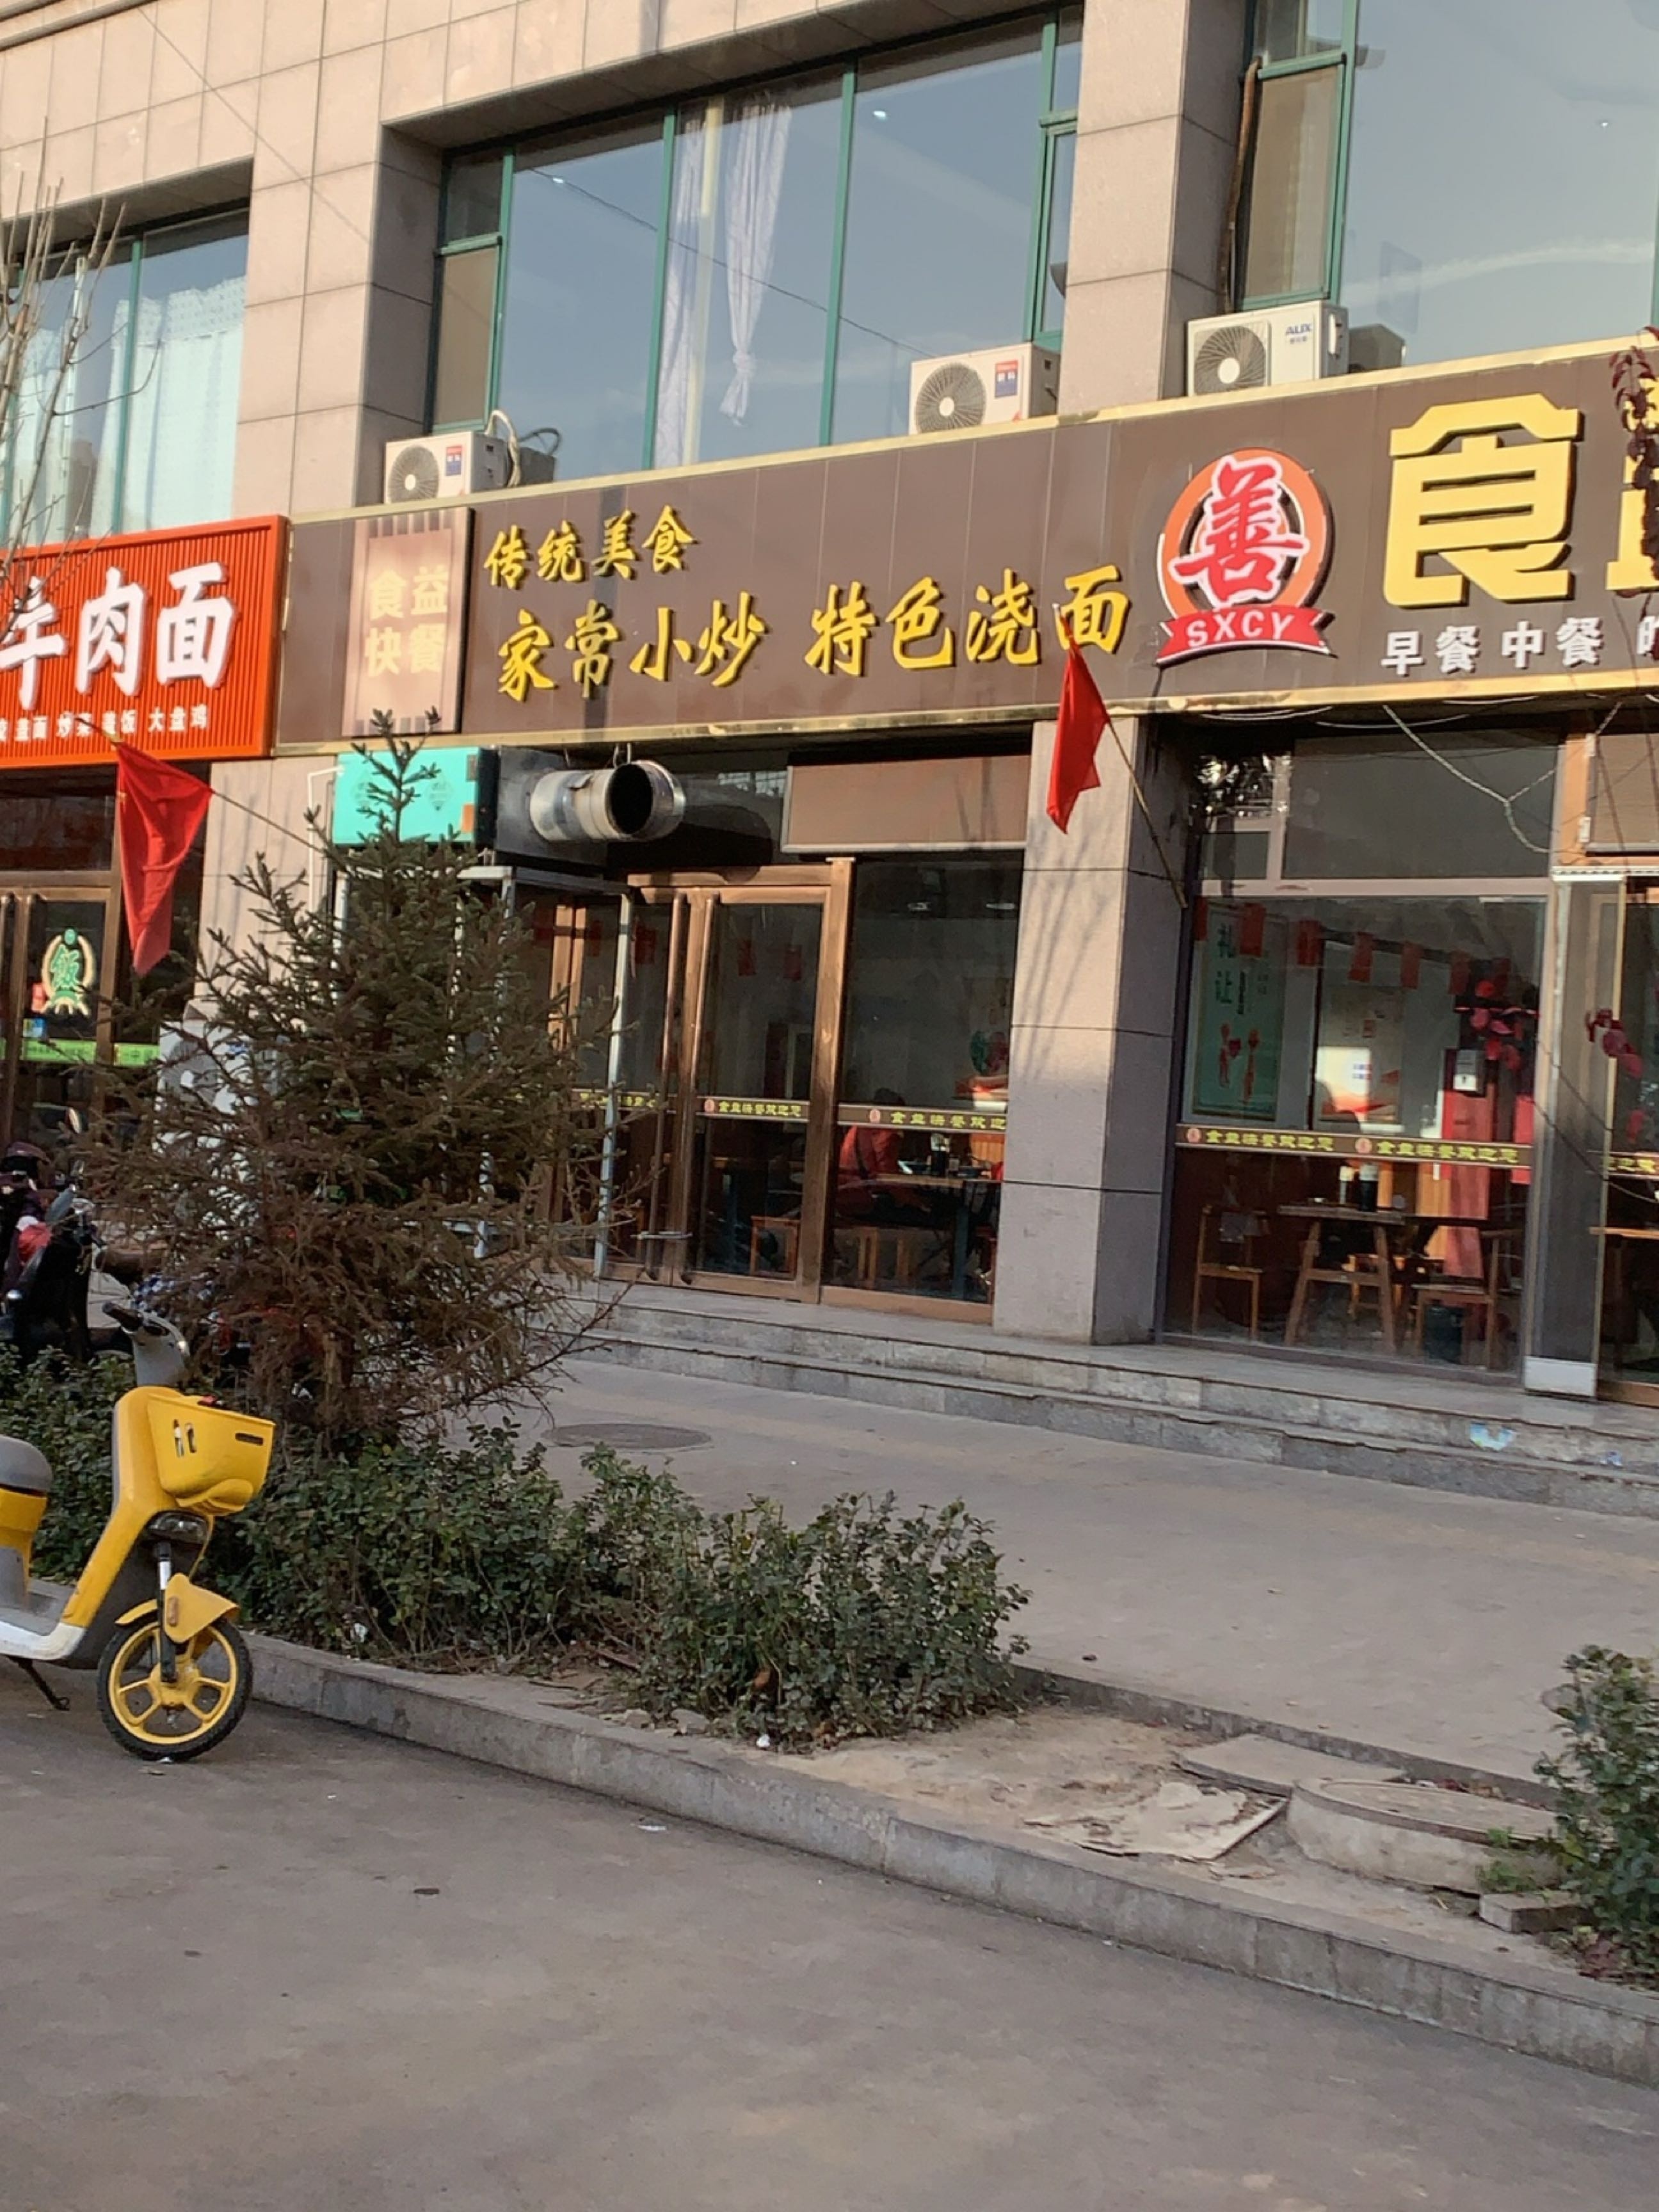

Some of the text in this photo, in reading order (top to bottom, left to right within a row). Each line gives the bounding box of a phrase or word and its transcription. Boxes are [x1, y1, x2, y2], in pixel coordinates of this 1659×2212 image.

[483, 504, 695, 589] 传统美食
[1170, 456, 1310, 608] 善
[367, 565, 449, 621] 食益
[364, 623, 446, 677] 快餐
[497, 565, 1130, 702] 家常小炒 特色浇面
[1187, 610, 1295, 648] SXCY
[1381, 624, 1480, 676] 早餐
[1501, 616, 1604, 669] 中餐
